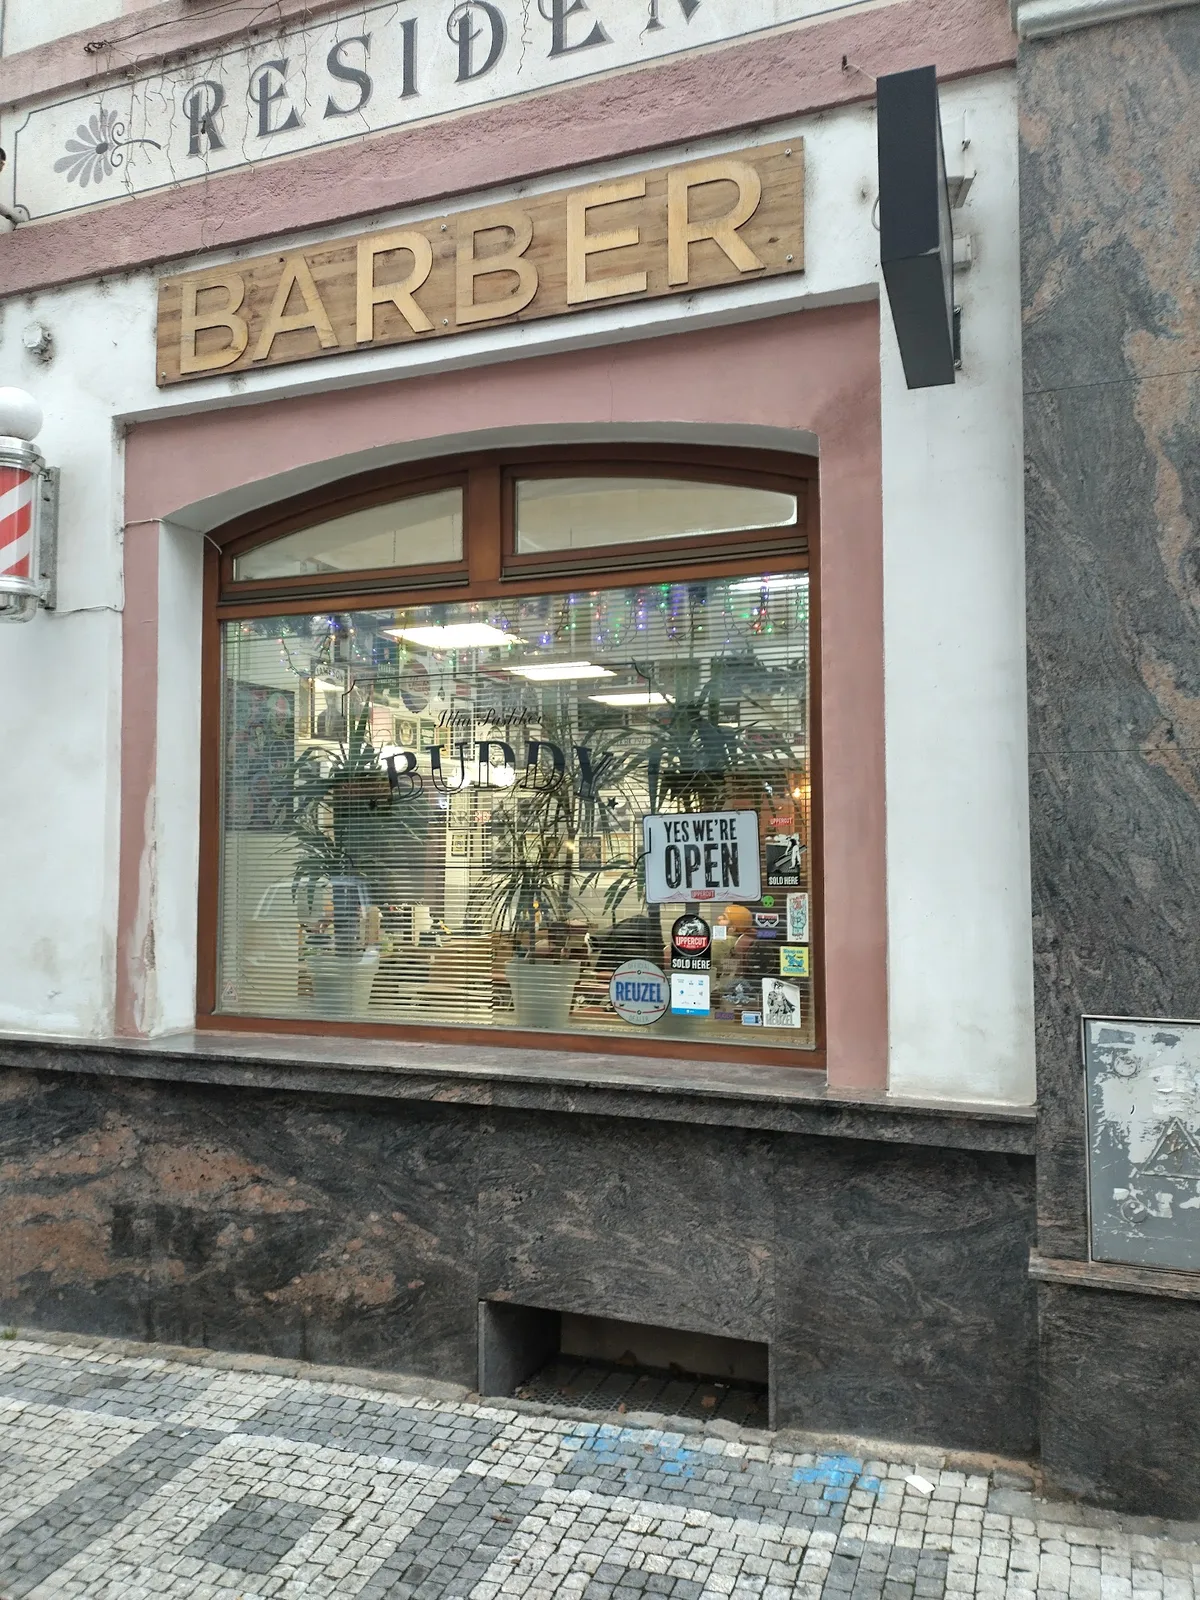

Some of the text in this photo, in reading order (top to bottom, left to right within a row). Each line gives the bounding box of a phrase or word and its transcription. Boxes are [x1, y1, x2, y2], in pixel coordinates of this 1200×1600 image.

[180, 159, 767, 375] BARBER
[380, 740, 614, 803] BUDDY
[664, 818, 737, 842] YES WE'RE
[665, 842, 740, 889] OPEN
[769, 876, 798, 885] SOLD HERE
[692, 890, 715, 898] UPPERCUT
[675, 936, 708, 947] UPPERCUT
[672, 958, 711, 970] SOLD HERE
[615, 981, 664, 1003] REUZEL
